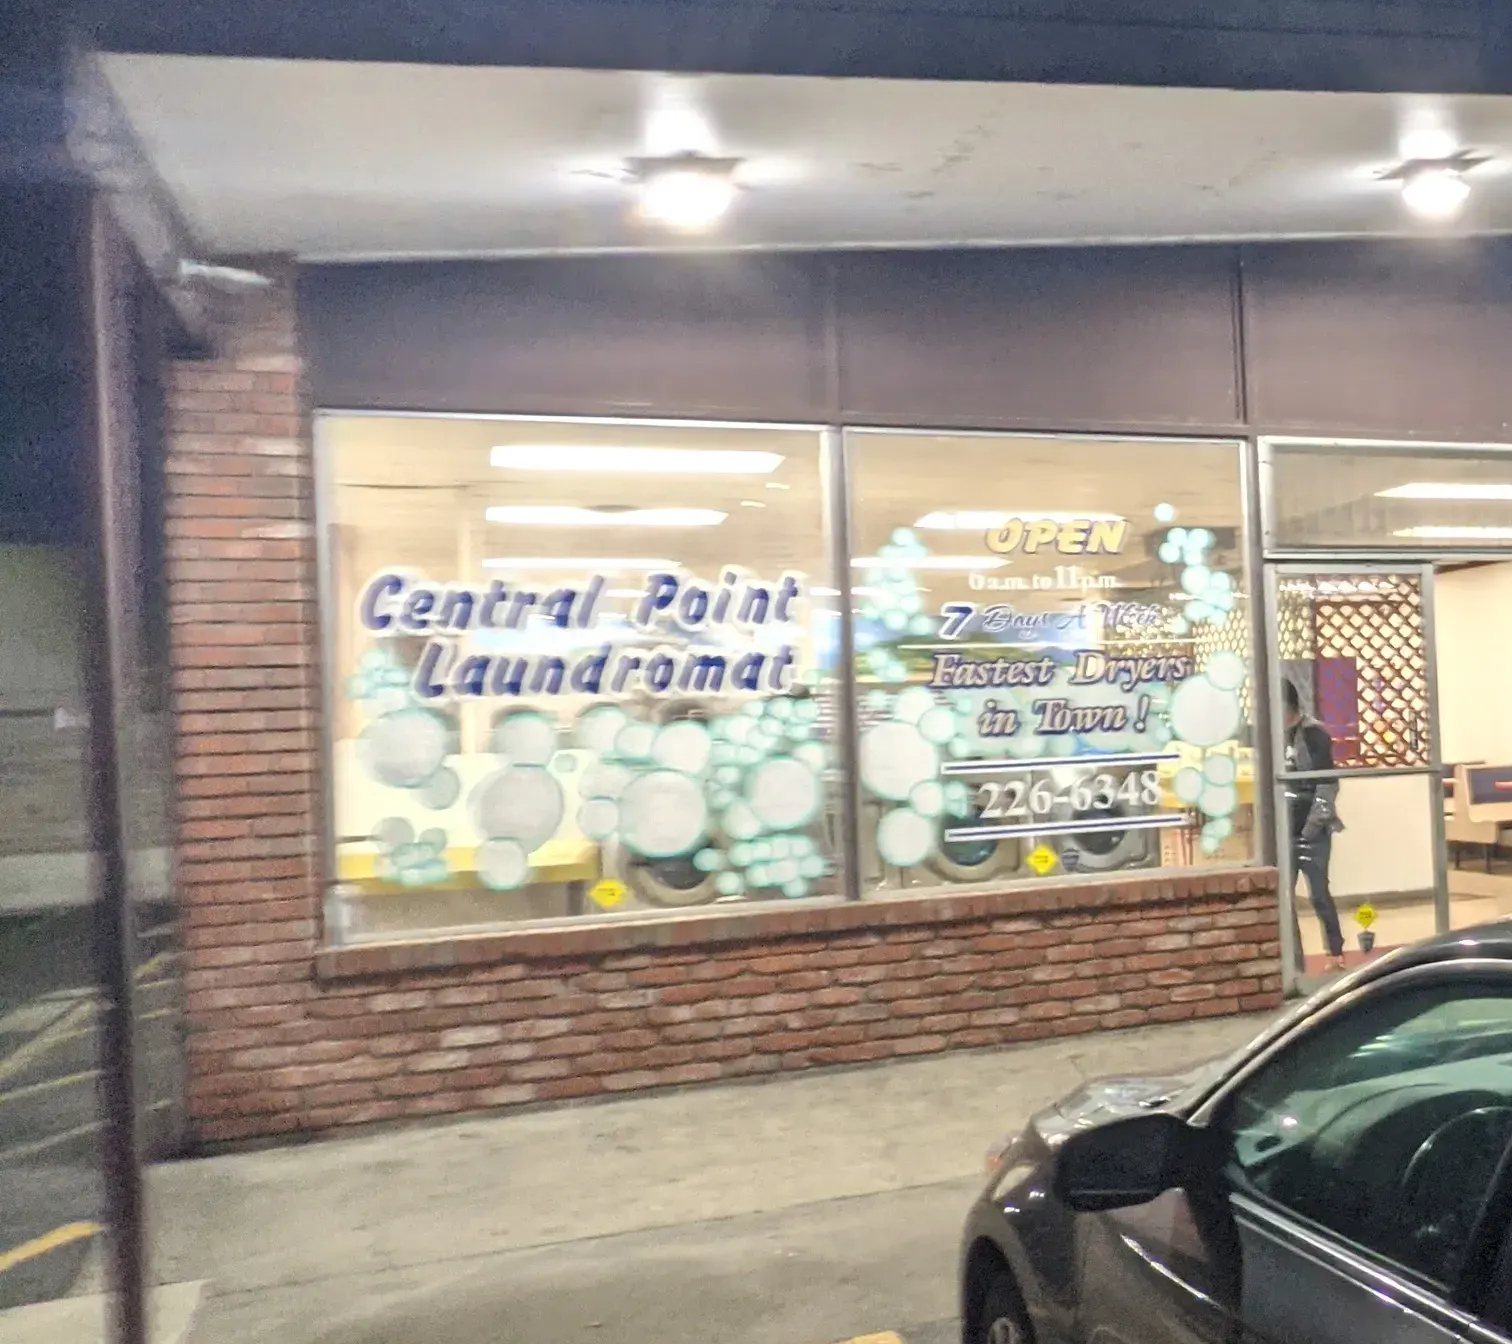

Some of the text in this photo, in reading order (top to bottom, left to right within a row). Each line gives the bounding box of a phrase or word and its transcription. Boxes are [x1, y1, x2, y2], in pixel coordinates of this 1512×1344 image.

[986, 518, 1129, 555] OPEN
[359, 569, 801, 633] Central Point
[940, 601, 978, 641] 7
[982, 604, 1048, 640] Days
[411, 640, 797, 700] Laundromat
[930, 649, 1193, 693] Fastest Dryers
[977, 699, 1020, 736] in
[977, 769, 1161, 820] 226-6348
